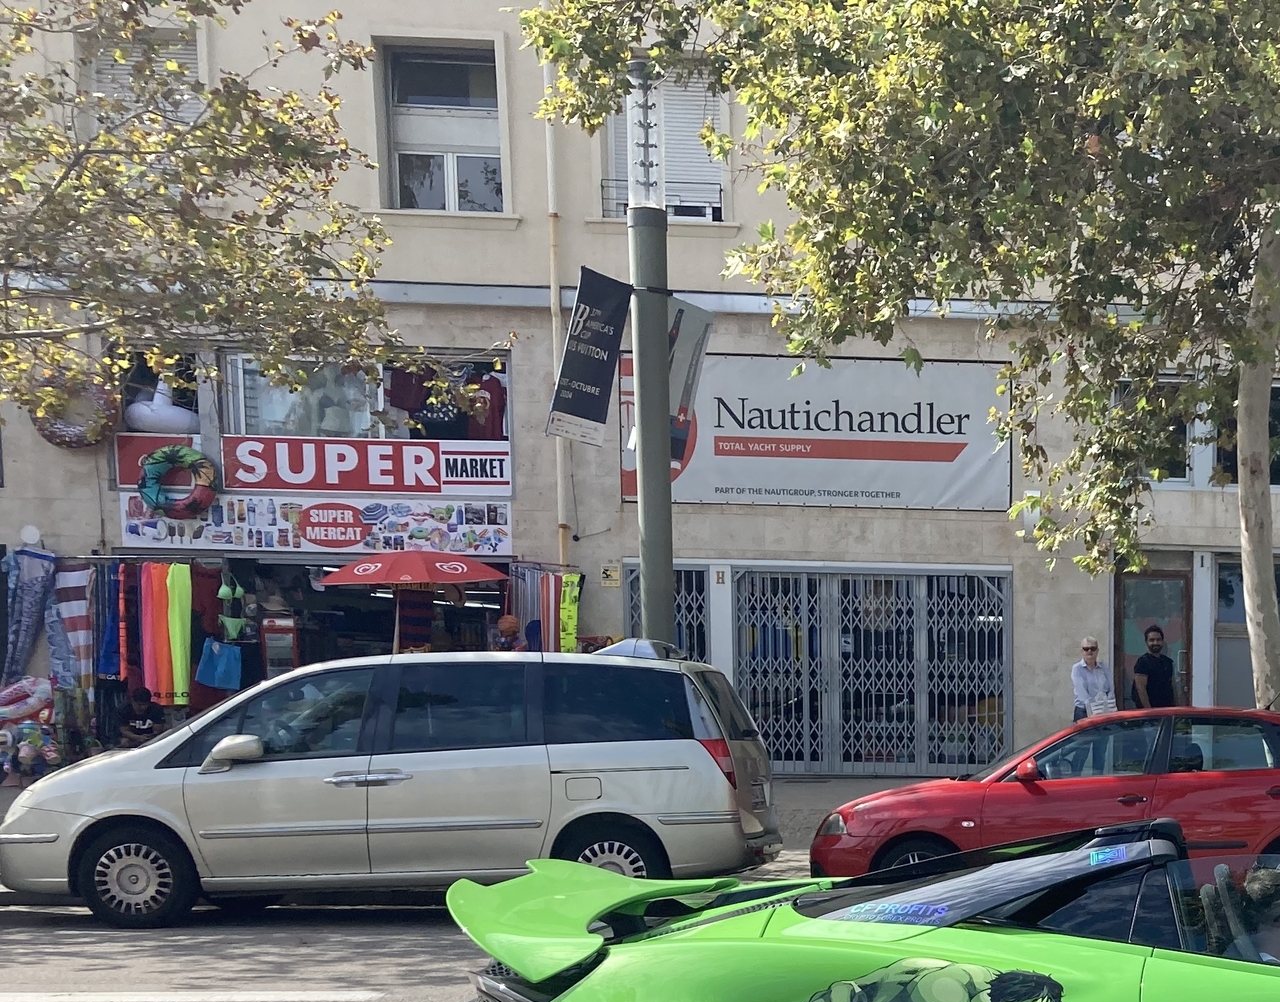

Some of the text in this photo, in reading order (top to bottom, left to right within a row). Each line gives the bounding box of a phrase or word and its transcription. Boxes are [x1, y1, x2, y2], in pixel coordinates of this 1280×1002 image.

[585, 320, 615, 336] AMERICA'S
[578, 342, 609, 361] VUITTON
[713, 396, 970, 435] Nautichandler
[718, 442, 811, 453] TOTAL YACHT SUPPLY
[235, 440, 506, 487] SUPER MARKET
[714, 486, 734, 494] PART
[747, 487, 763, 495] THE
[764, 488, 817, 497] NAUTIGROUP,
[817, 489, 859, 498] STRONGER
[860, 490, 901, 498] TOGETHER
[309, 509, 354, 524] SUPER
[306, 526, 363, 541] MERCAT
[850, 903, 949, 917] CF PROFITS
[876, 914, 905, 922] FOREX
[904, 915, 941, 925] PROFITS
